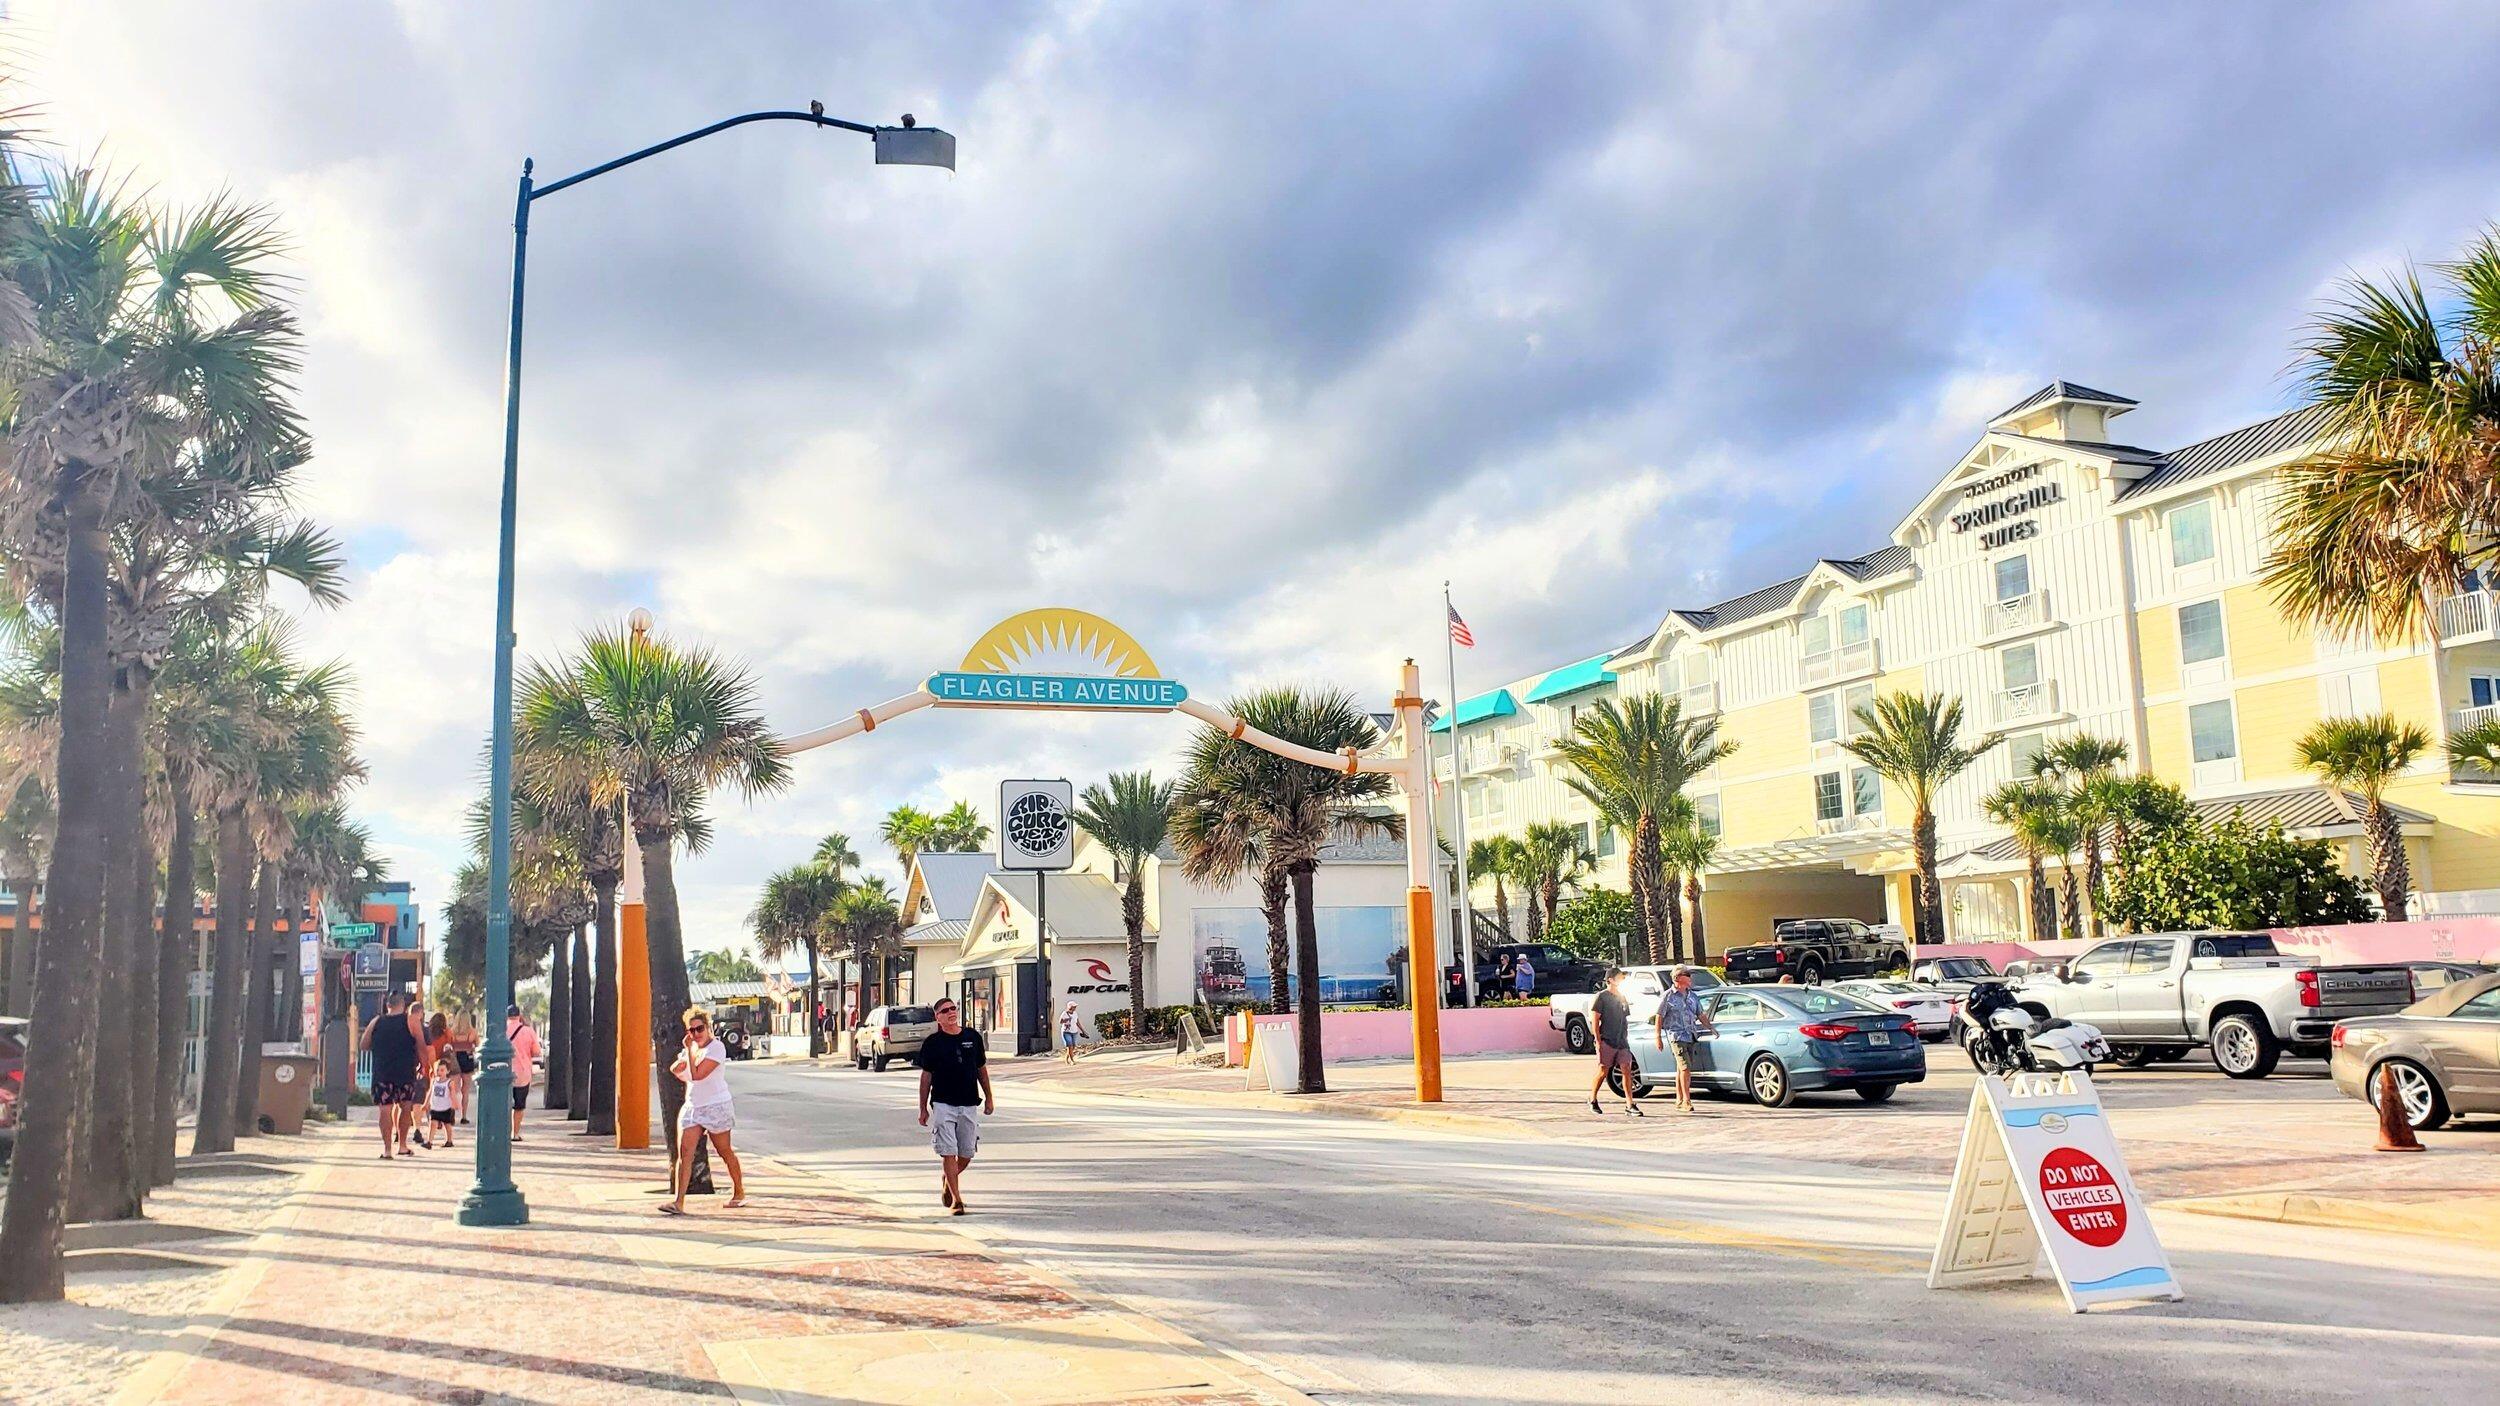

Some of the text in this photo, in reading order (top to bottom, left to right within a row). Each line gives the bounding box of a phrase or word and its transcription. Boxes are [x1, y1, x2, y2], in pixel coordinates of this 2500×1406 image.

[1964, 463, 2040, 499] MARRIOTT
[1951, 482, 2065, 534] SPRINGHILL
[1979, 520, 2038, 550] SUITES
[943, 677, 1174, 702] FLAGLER AVENUE
[1010, 794, 1049, 816] RIP
[1008, 811, 1068, 833] CURL
[355, 980, 387, 988] PARKING
[1067, 984, 1130, 994] RIP CUR
[2325, 980, 2404, 989] CHEVROLET
[2044, 1164, 2100, 1185] DO NOT
[2052, 1188, 2114, 1207] VEHICLES
[2068, 1211, 2118, 1231] ENTER
